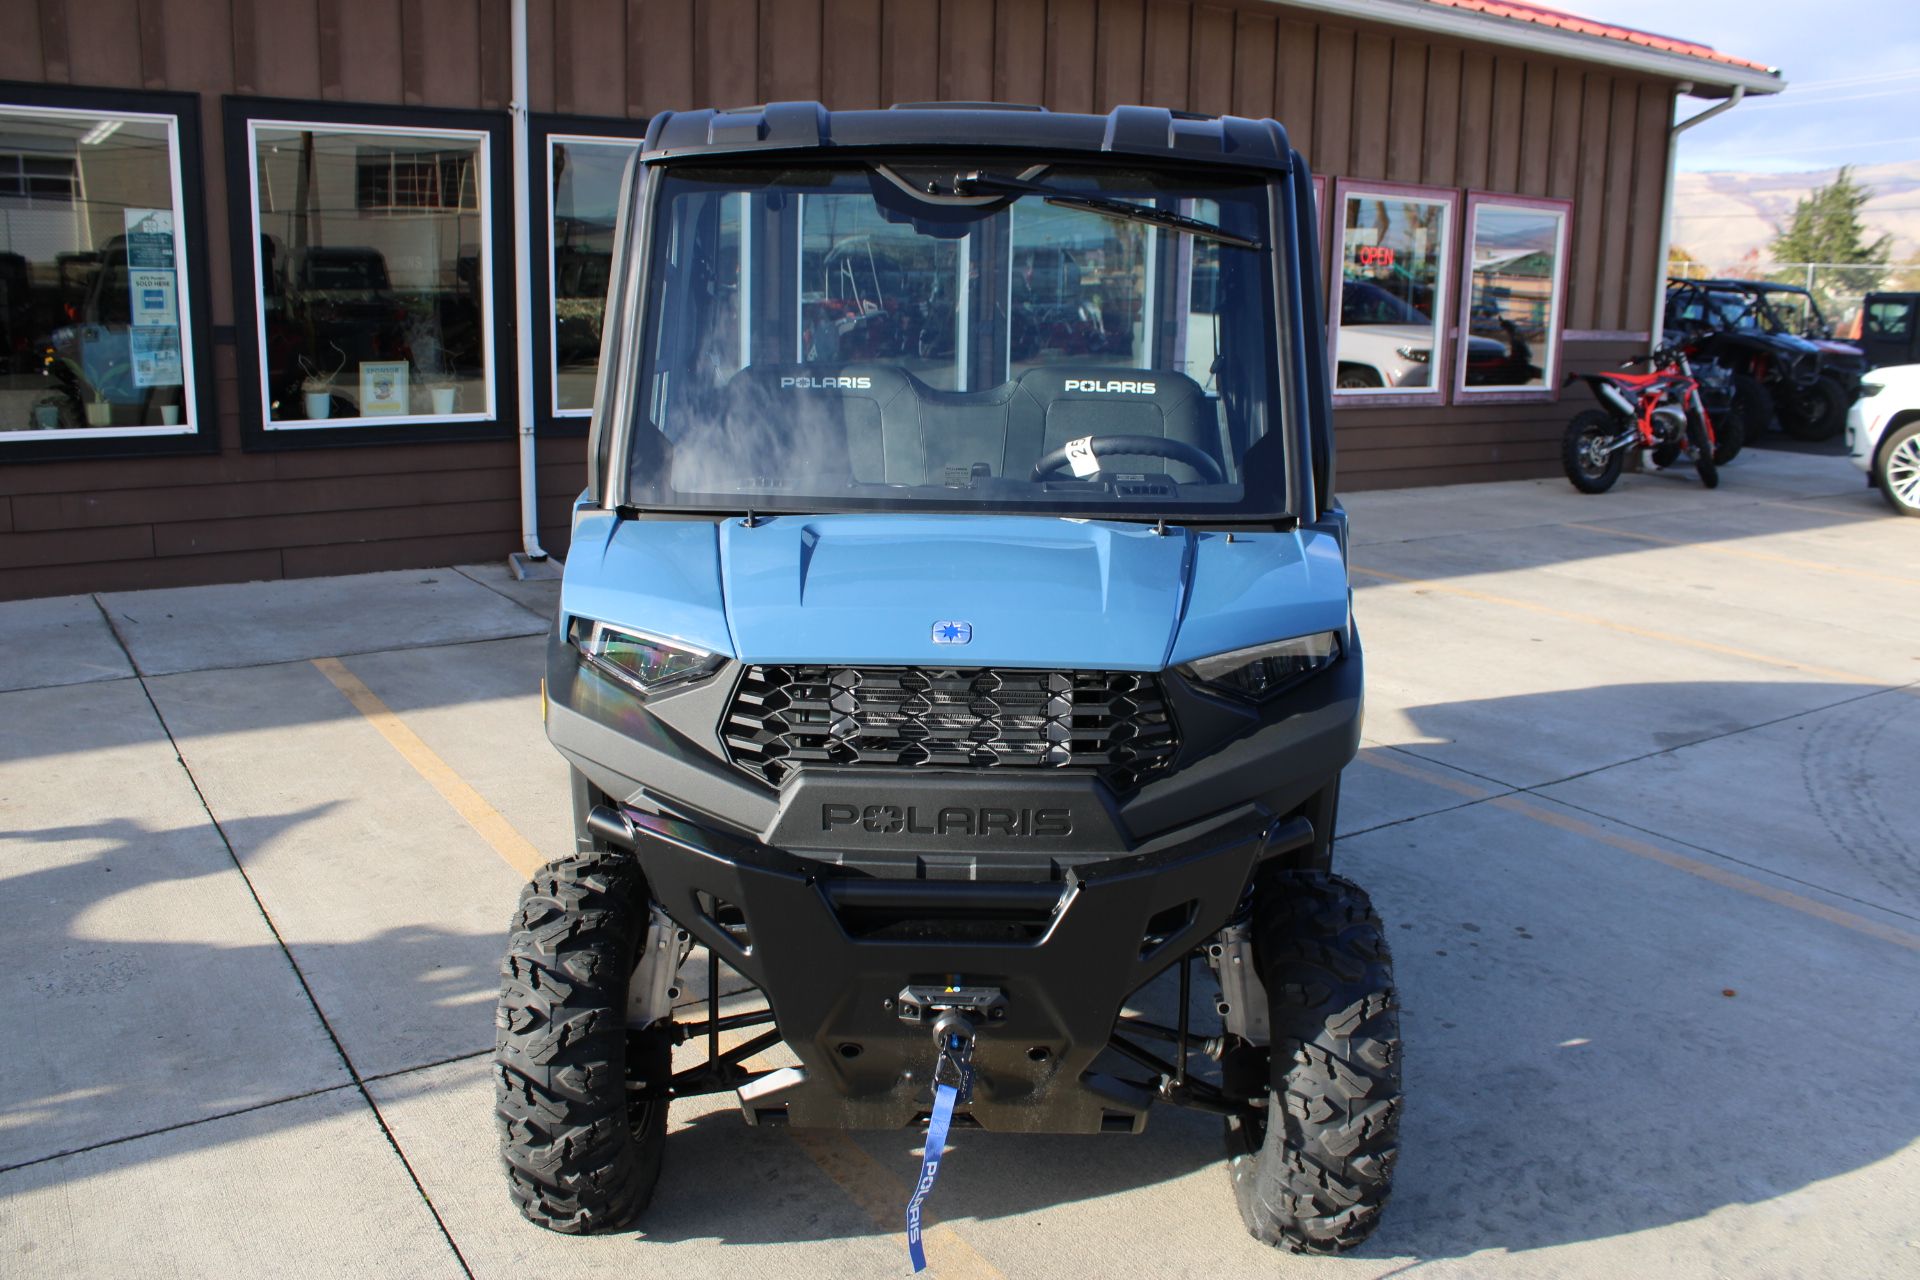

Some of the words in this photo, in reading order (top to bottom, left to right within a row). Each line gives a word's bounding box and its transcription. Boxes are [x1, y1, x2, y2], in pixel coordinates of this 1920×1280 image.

[1361, 245, 1394, 266] OPEN
[781, 377, 871, 389] POLARIS
[1065, 380, 1156, 394] POLARIS
[822, 803, 1073, 836] POLARIS
[910, 1161, 938, 1245] POLARIS
